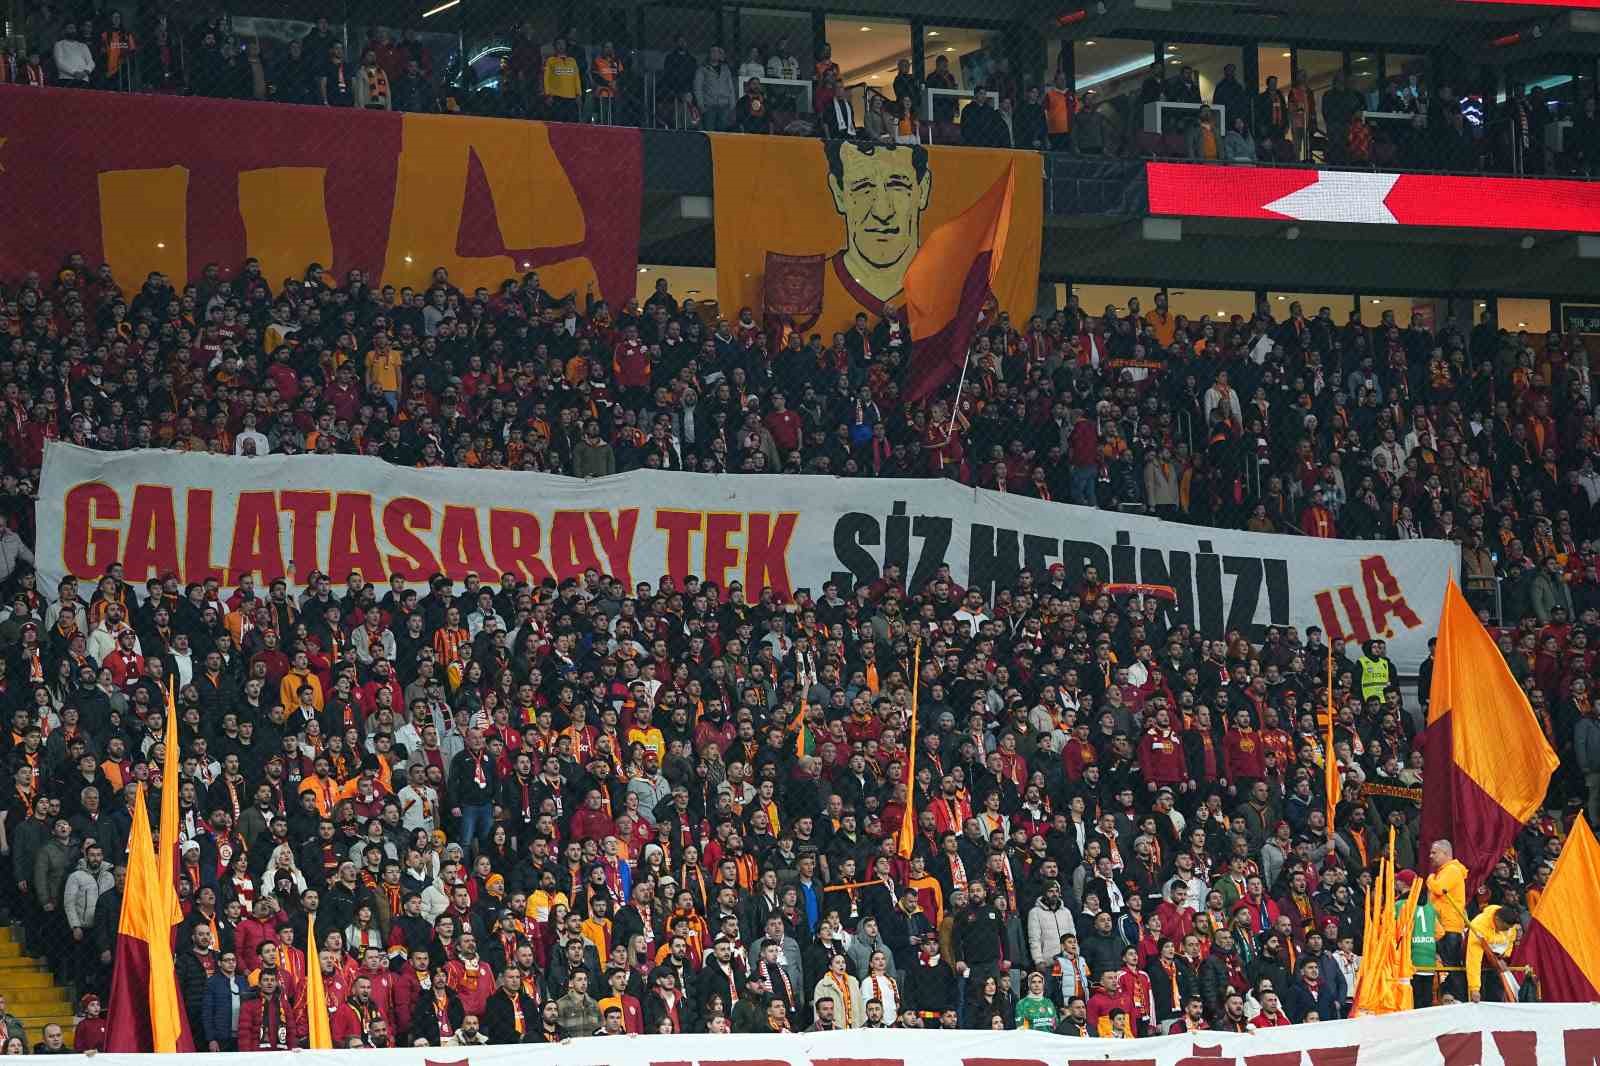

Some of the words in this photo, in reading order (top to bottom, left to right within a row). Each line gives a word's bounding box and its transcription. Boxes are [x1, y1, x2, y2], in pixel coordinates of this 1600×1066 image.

[63, 480, 640, 592] GALATASARAY
[831, 500, 953, 600] SİZ
[1417, 906, 1427, 933] 1
